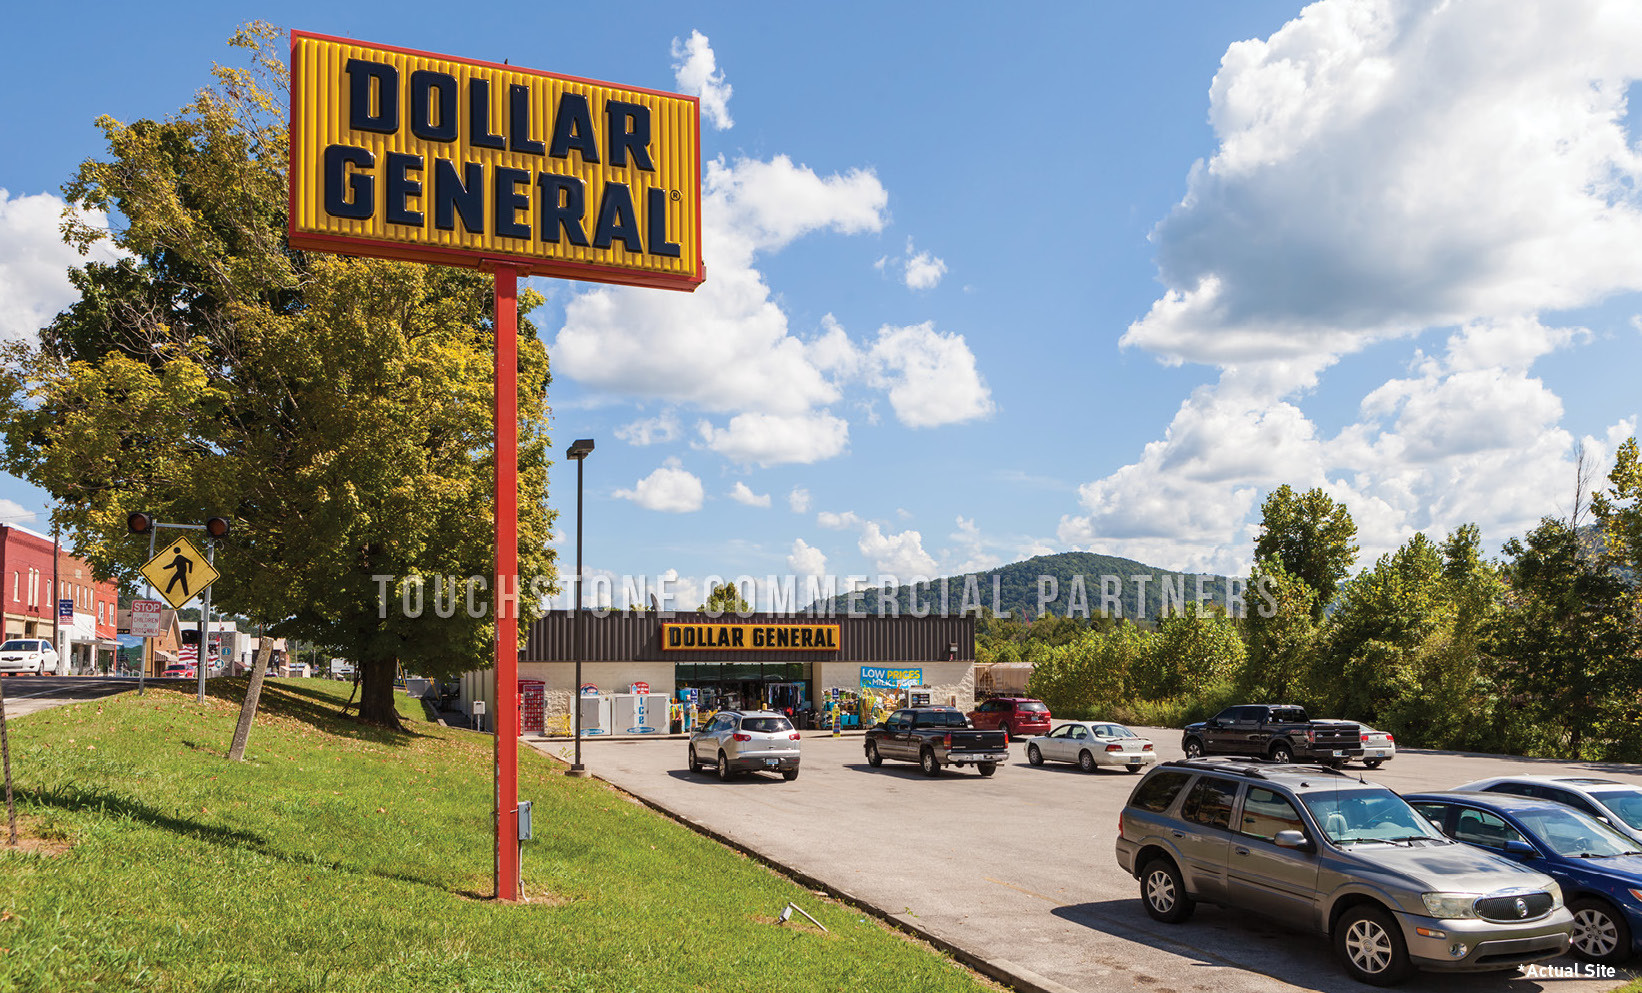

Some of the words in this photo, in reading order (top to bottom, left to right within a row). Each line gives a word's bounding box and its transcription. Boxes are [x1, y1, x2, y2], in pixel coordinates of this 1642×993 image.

[345, 57, 656, 172] DOLLAR
[134, 602, 160, 612] STOP
[669, 626, 744, 647] DOLLAR
[752, 627, 836, 647] GENERAL
[862, 668, 885, 679] LOW
[887, 670, 920, 680] PRICES
